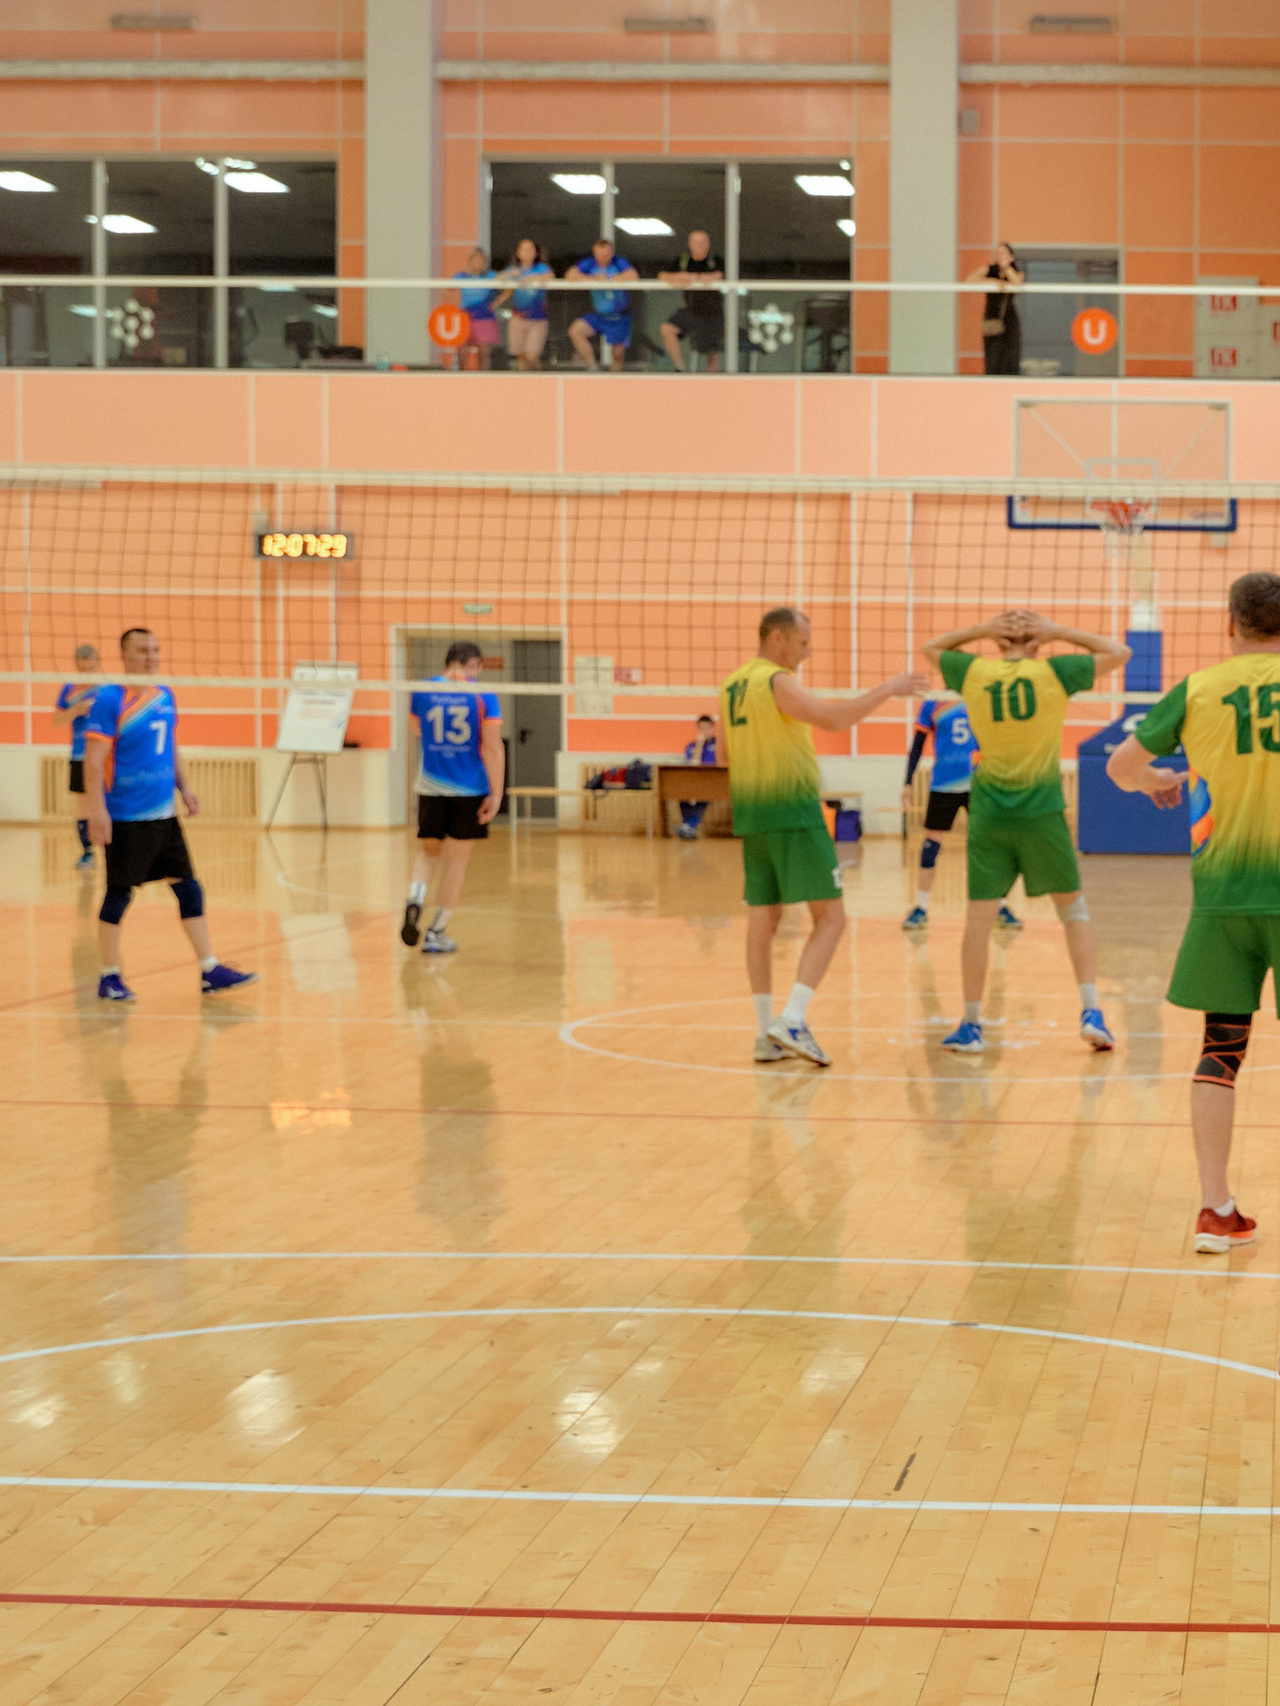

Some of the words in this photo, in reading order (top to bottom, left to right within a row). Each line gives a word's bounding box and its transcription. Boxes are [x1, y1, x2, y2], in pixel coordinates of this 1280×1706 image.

[437, 313, 461, 341] U
[1083, 319, 1107, 345] U
[983, 677, 1037, 722] 10
[427, 705, 471, 744] 13
[951, 718, 970, 745] 5
